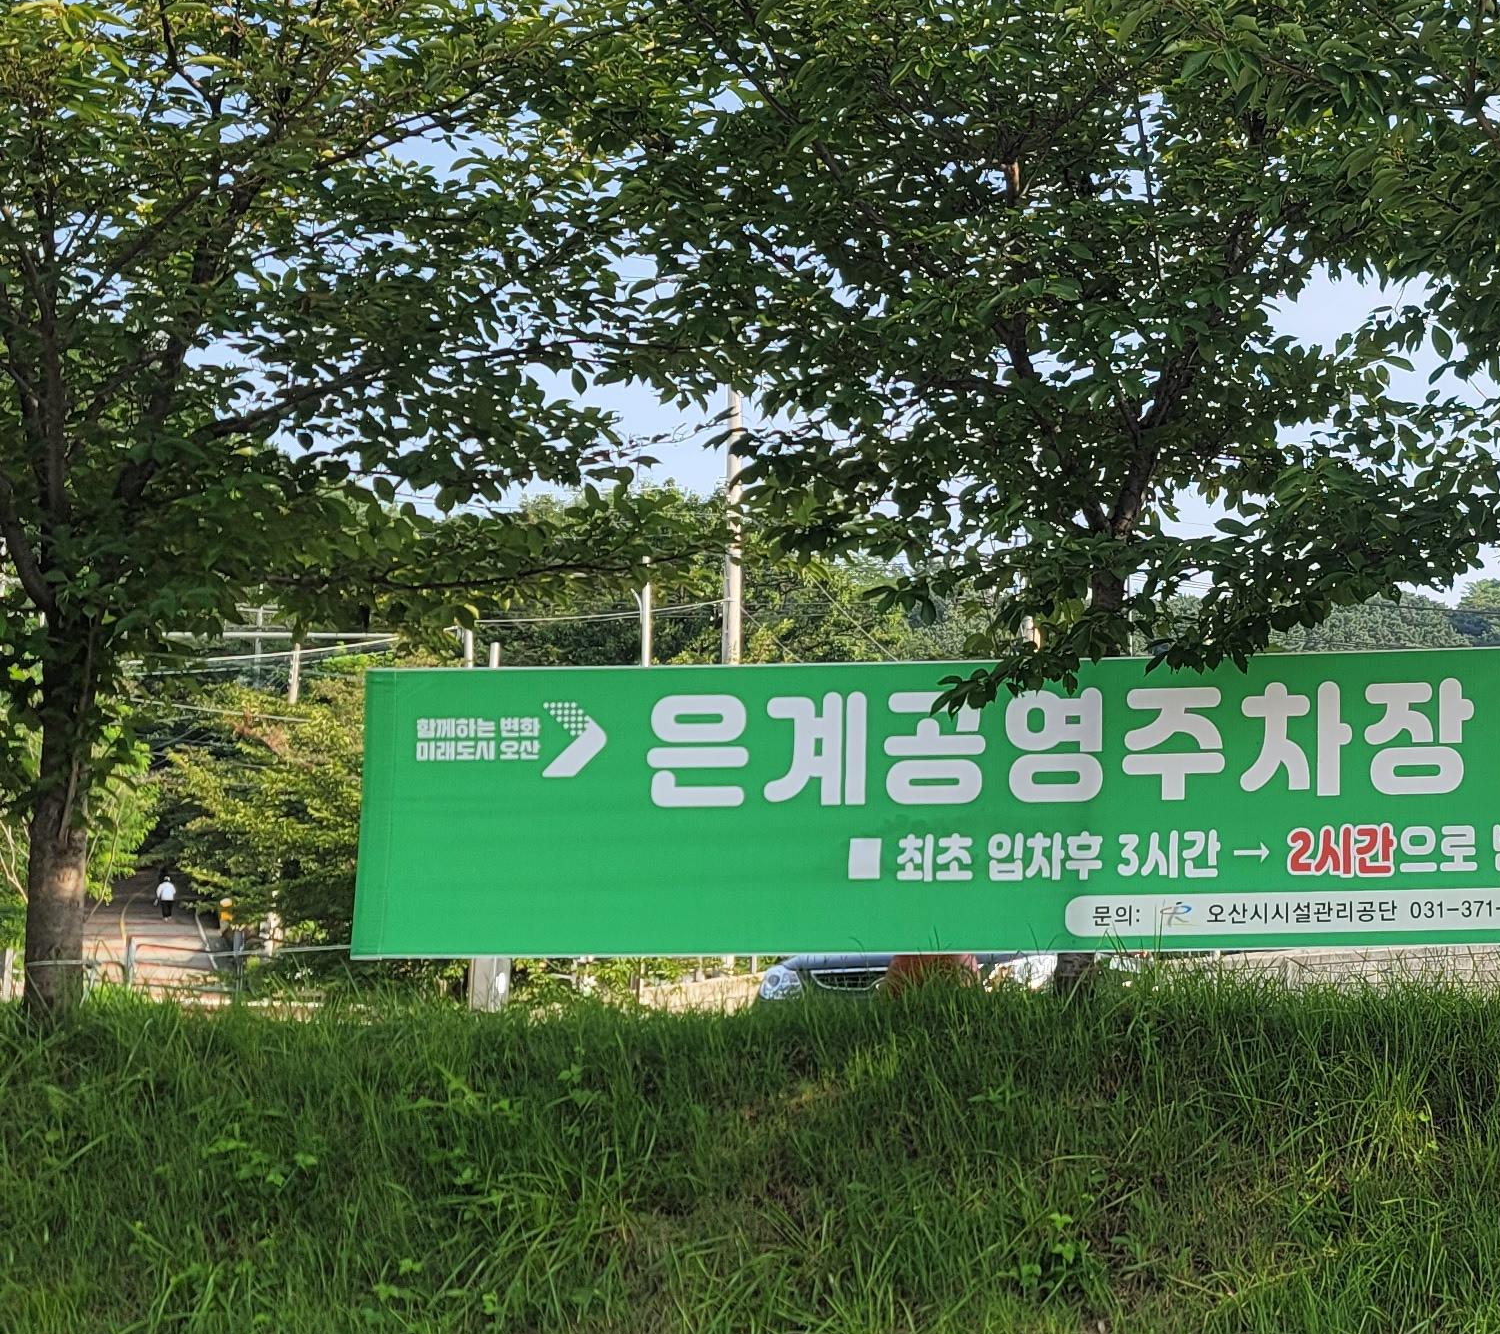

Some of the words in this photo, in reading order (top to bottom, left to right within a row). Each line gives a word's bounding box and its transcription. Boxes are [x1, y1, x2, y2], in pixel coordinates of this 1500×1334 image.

[416, 717, 496, 739] 함께하는
[499, 717, 541, 738] 변화
[415, 740, 496, 761] 미래도시
[499, 739, 541, 760] 오산
[646, 677, 1475, 808] 은계공영주차장
[896, 832, 973, 882] 최초
[987, 830, 1104, 881] 입차후
[1117, 829, 1222, 879] 3시간
[1286, 822, 1478, 879] 2시간으로
[1092, 905, 1140, 927] 문의:
[1206, 900, 1398, 924] 오산시시설관리공단
